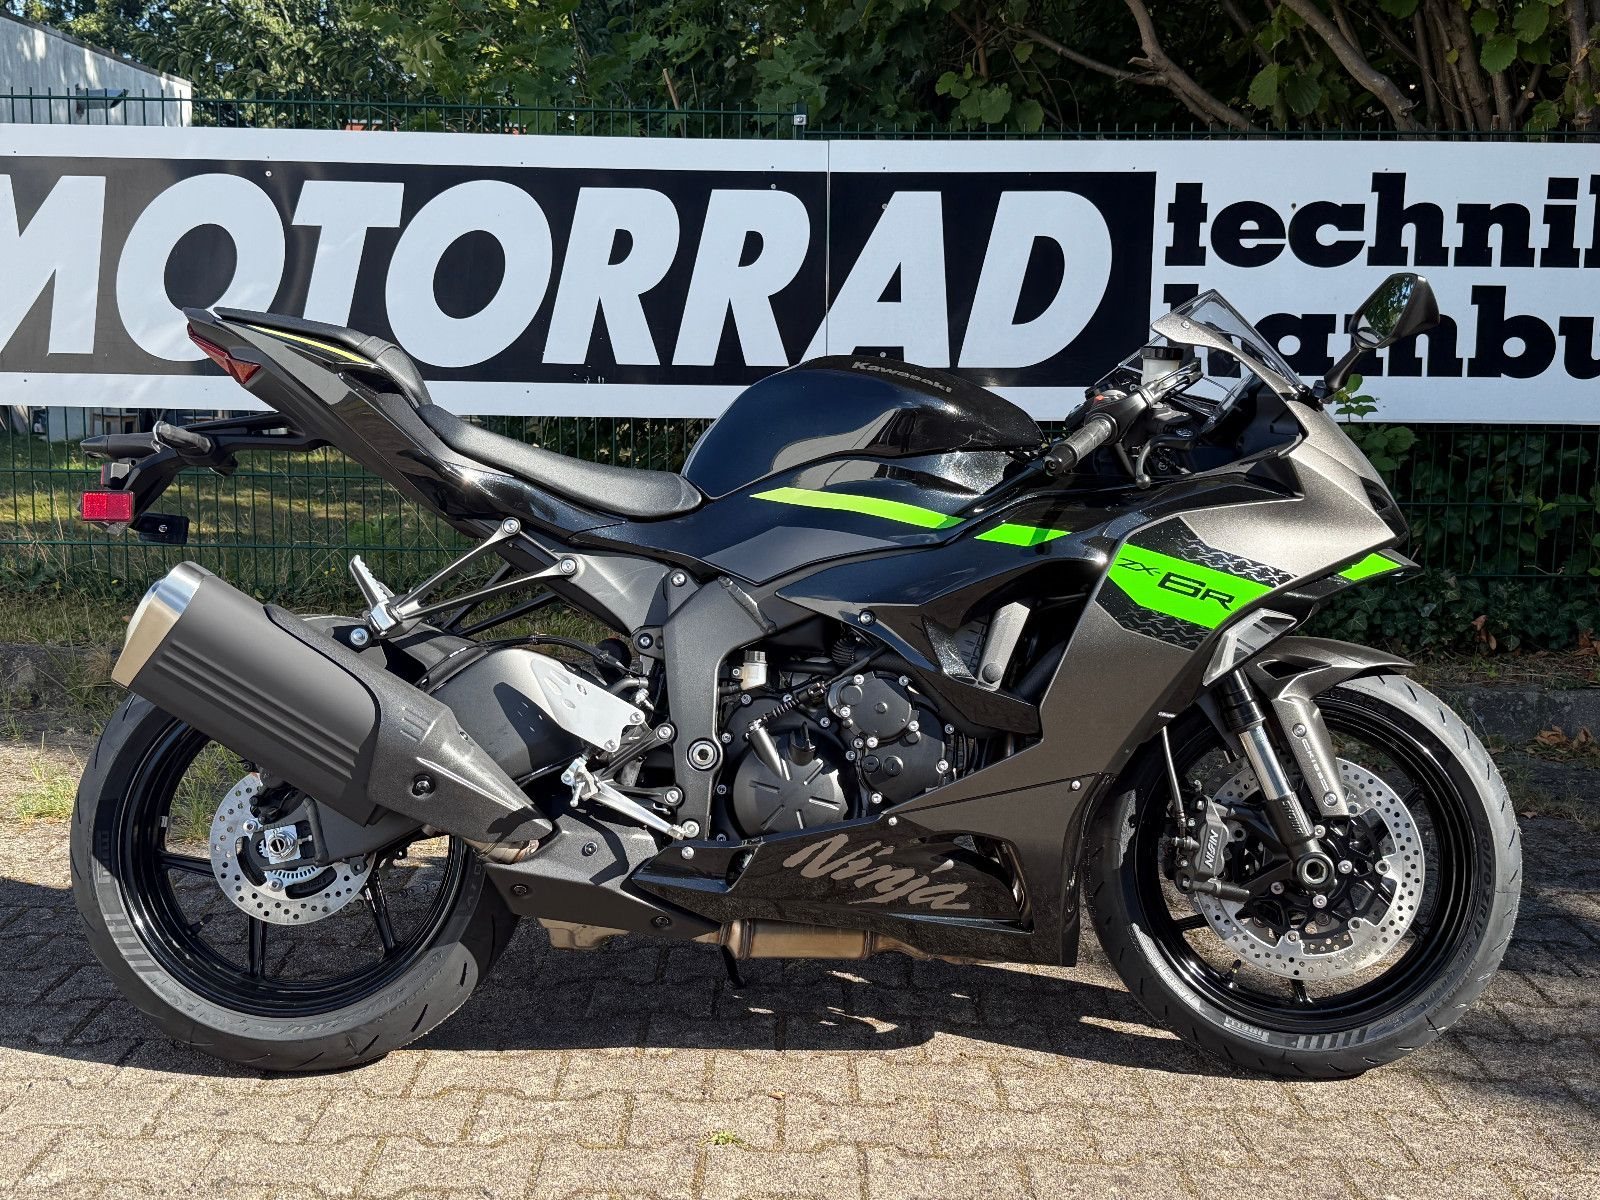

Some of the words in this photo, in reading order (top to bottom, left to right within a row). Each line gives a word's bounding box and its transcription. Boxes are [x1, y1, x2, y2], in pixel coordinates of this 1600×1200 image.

[0, 173, 1113, 369] MOTORRAD
[1164, 172, 1600, 269] techni
[851, 361, 953, 393] Kawasaki
[782, 833, 971, 911] Ninja
